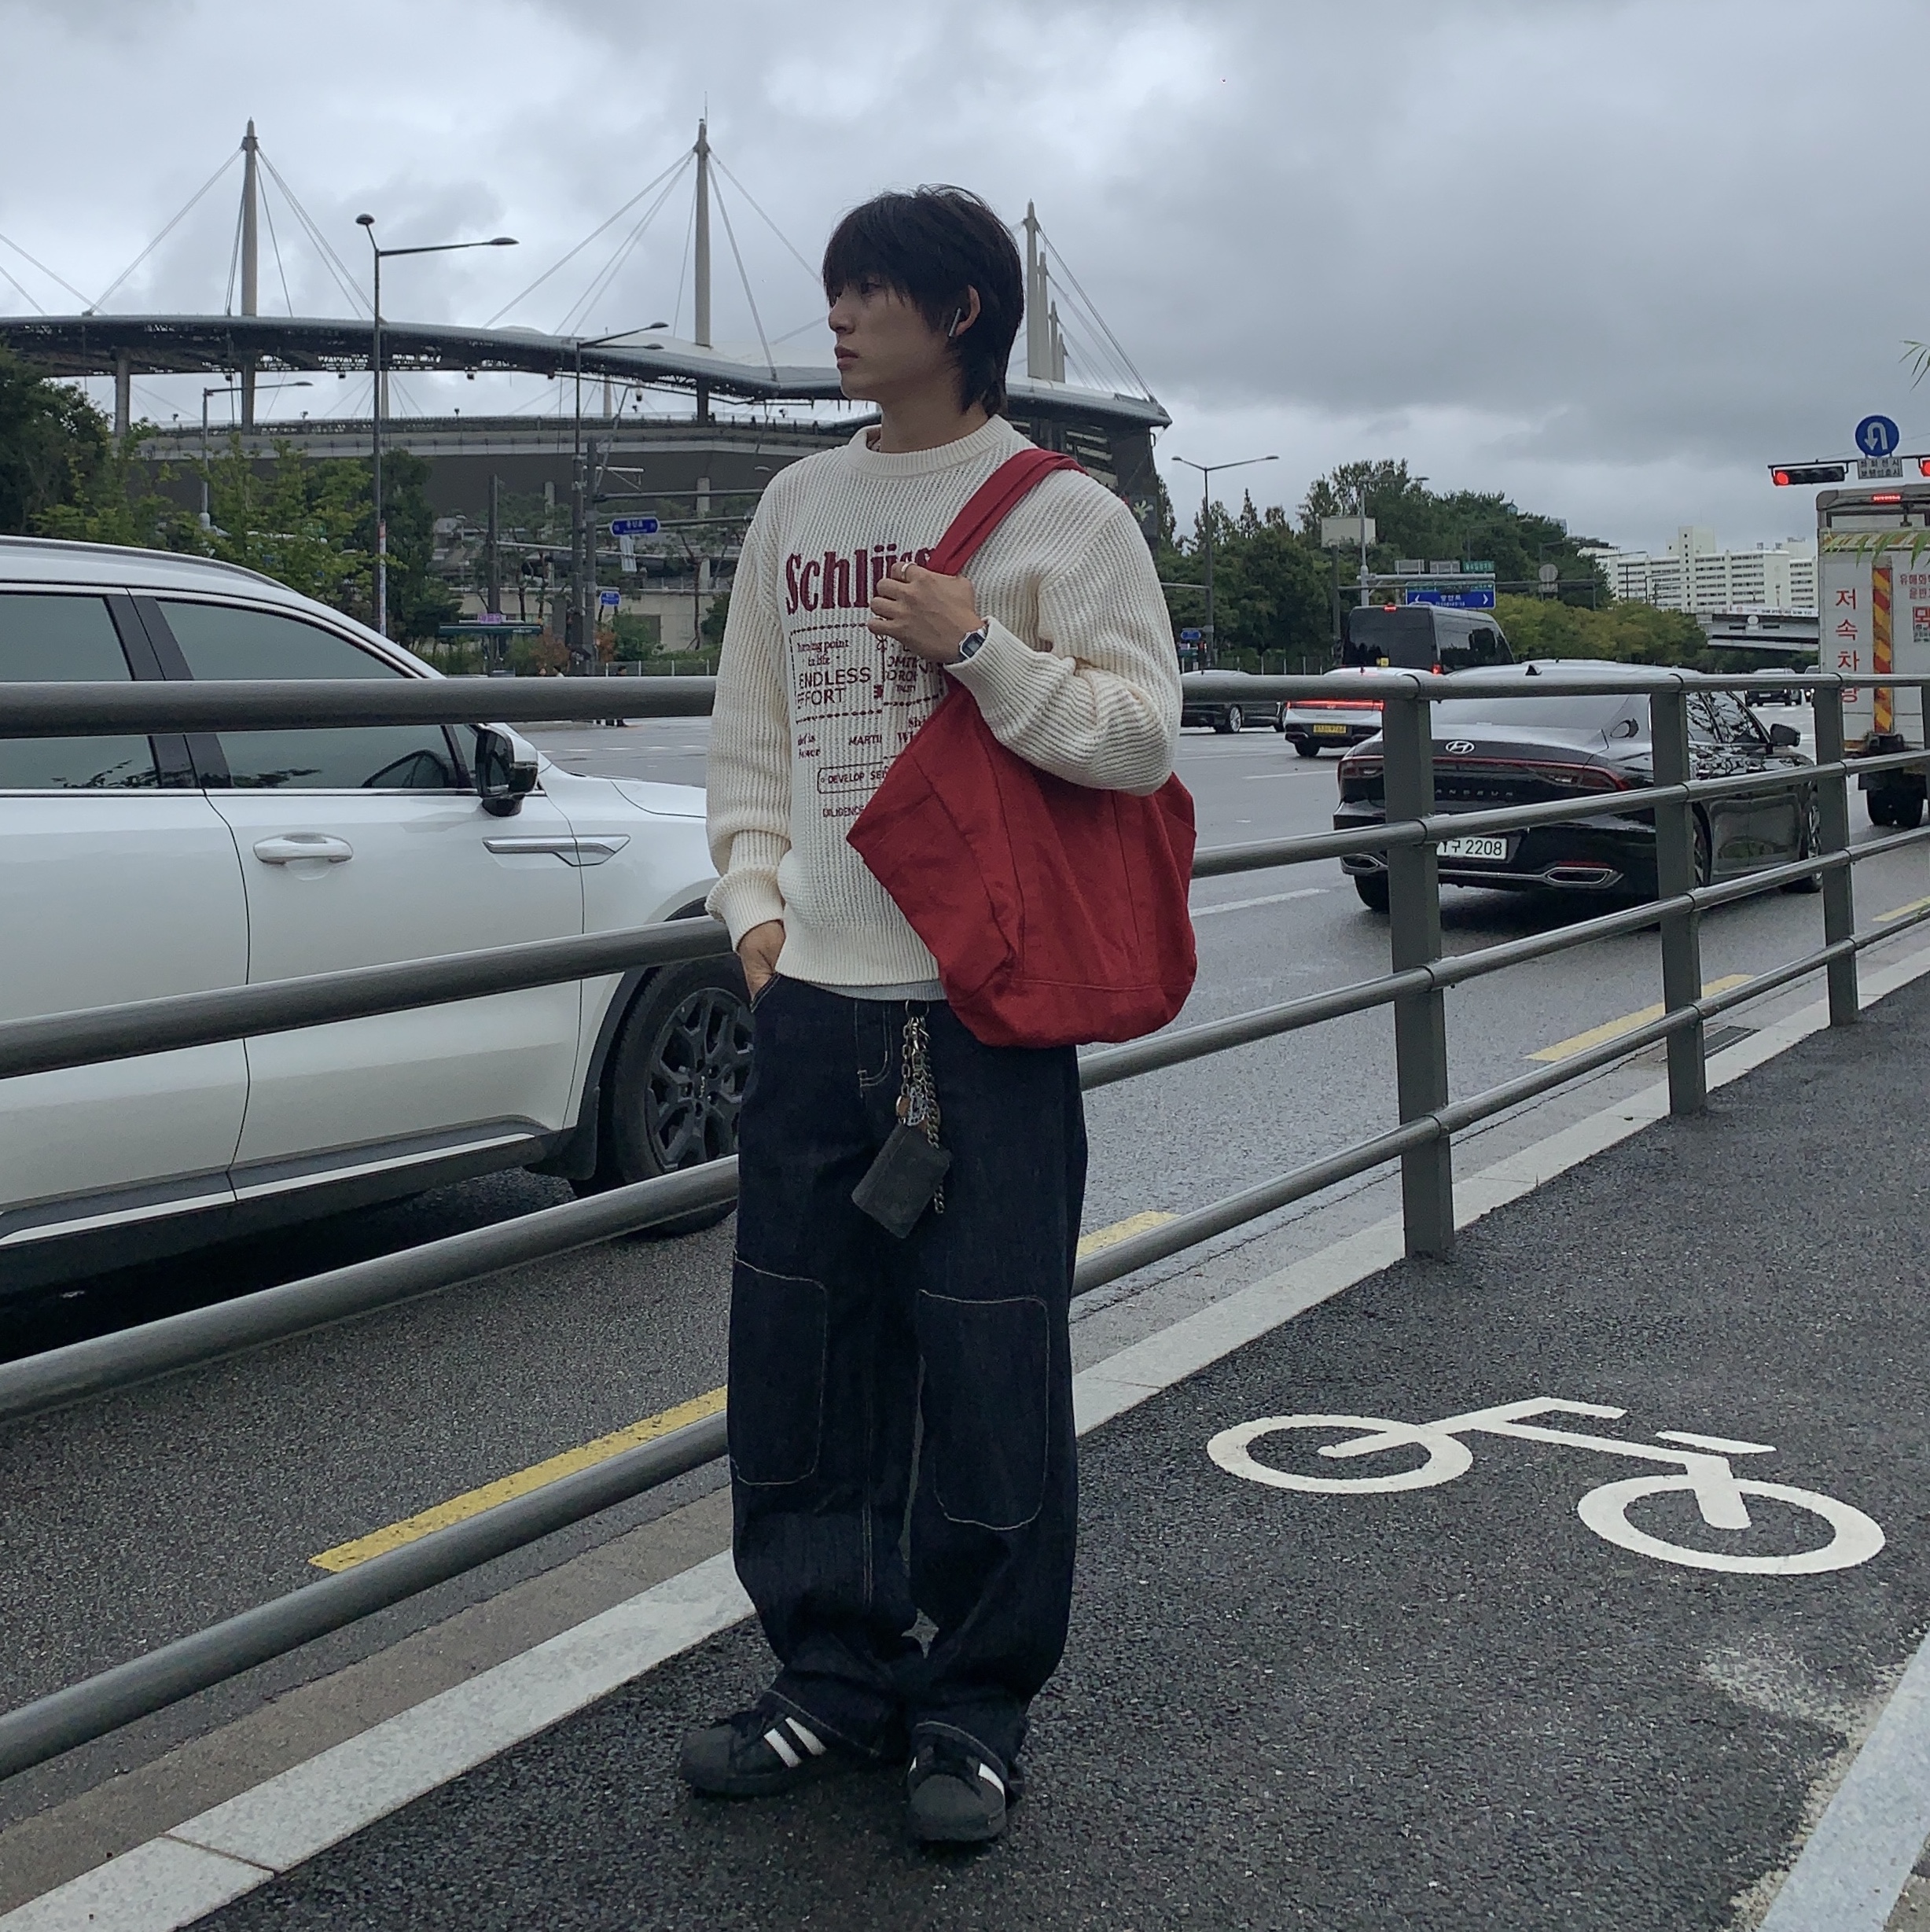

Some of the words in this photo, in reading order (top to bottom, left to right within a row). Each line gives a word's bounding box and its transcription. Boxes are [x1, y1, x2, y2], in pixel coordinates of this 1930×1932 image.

[824, 638, 849, 654] point
[799, 667, 871, 690] ENDLESS
[828, 772, 865, 785] DEVELOP
[1435, 788, 1514, 797] ANDEUR
[1465, 839, 1502, 856] 2208
